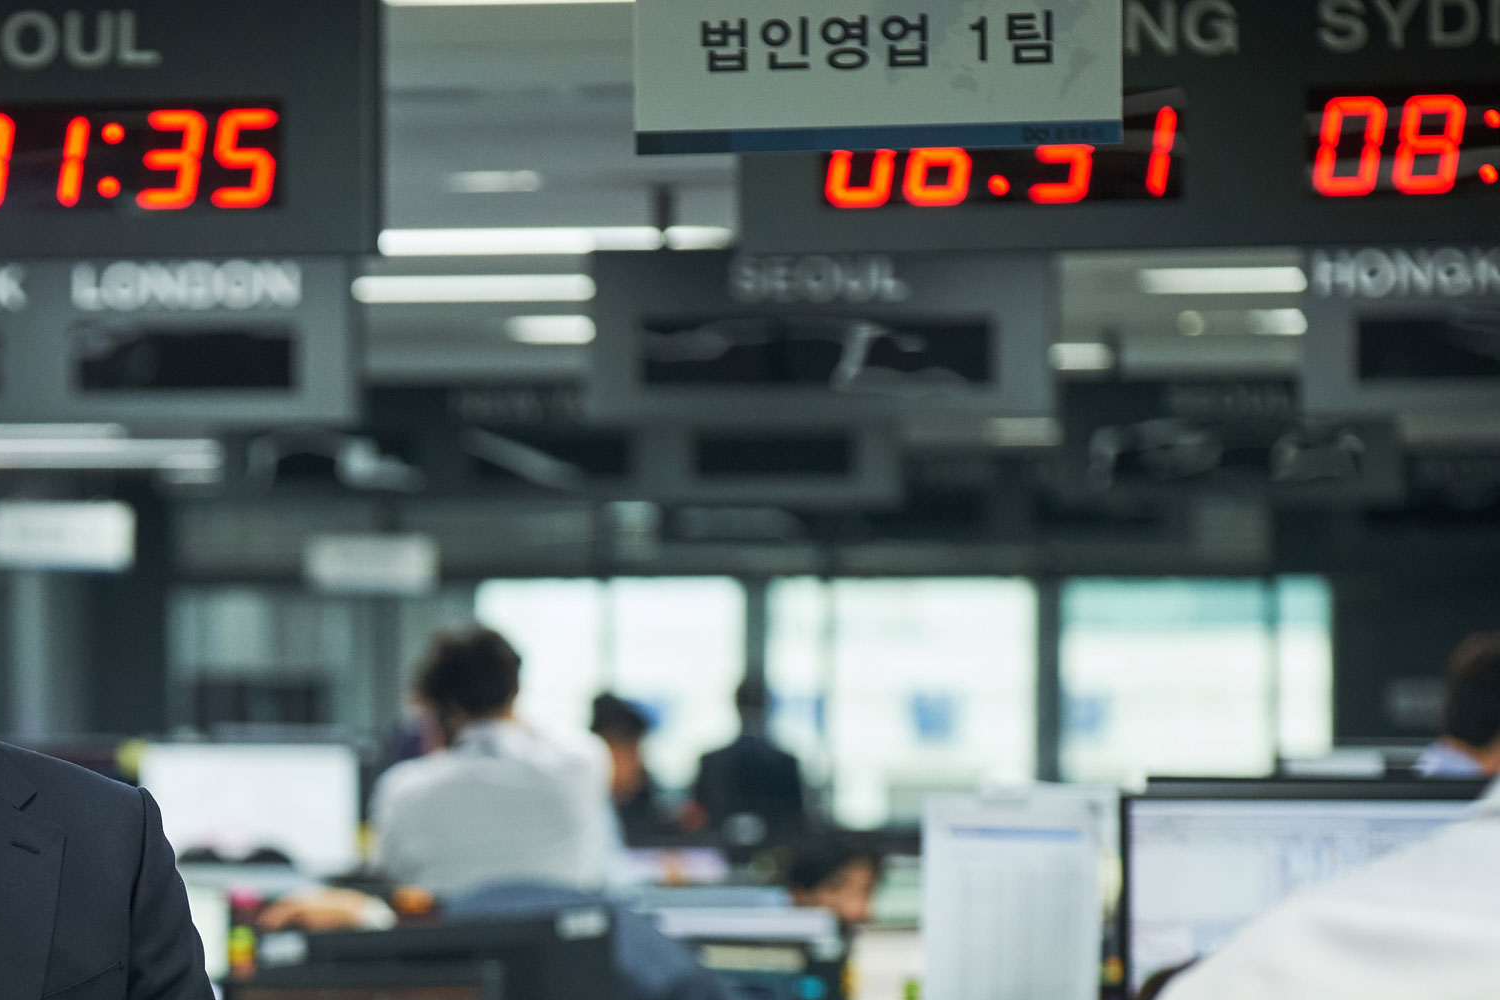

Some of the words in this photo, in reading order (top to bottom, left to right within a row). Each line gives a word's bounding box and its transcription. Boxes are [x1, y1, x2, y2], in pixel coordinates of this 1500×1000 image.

[700, 12, 930, 74] 법인영업
[969, 8, 1055, 66] 1팀
[69, 259, 304, 313] LONDON
[730, 254, 910, 304] SEOUL
